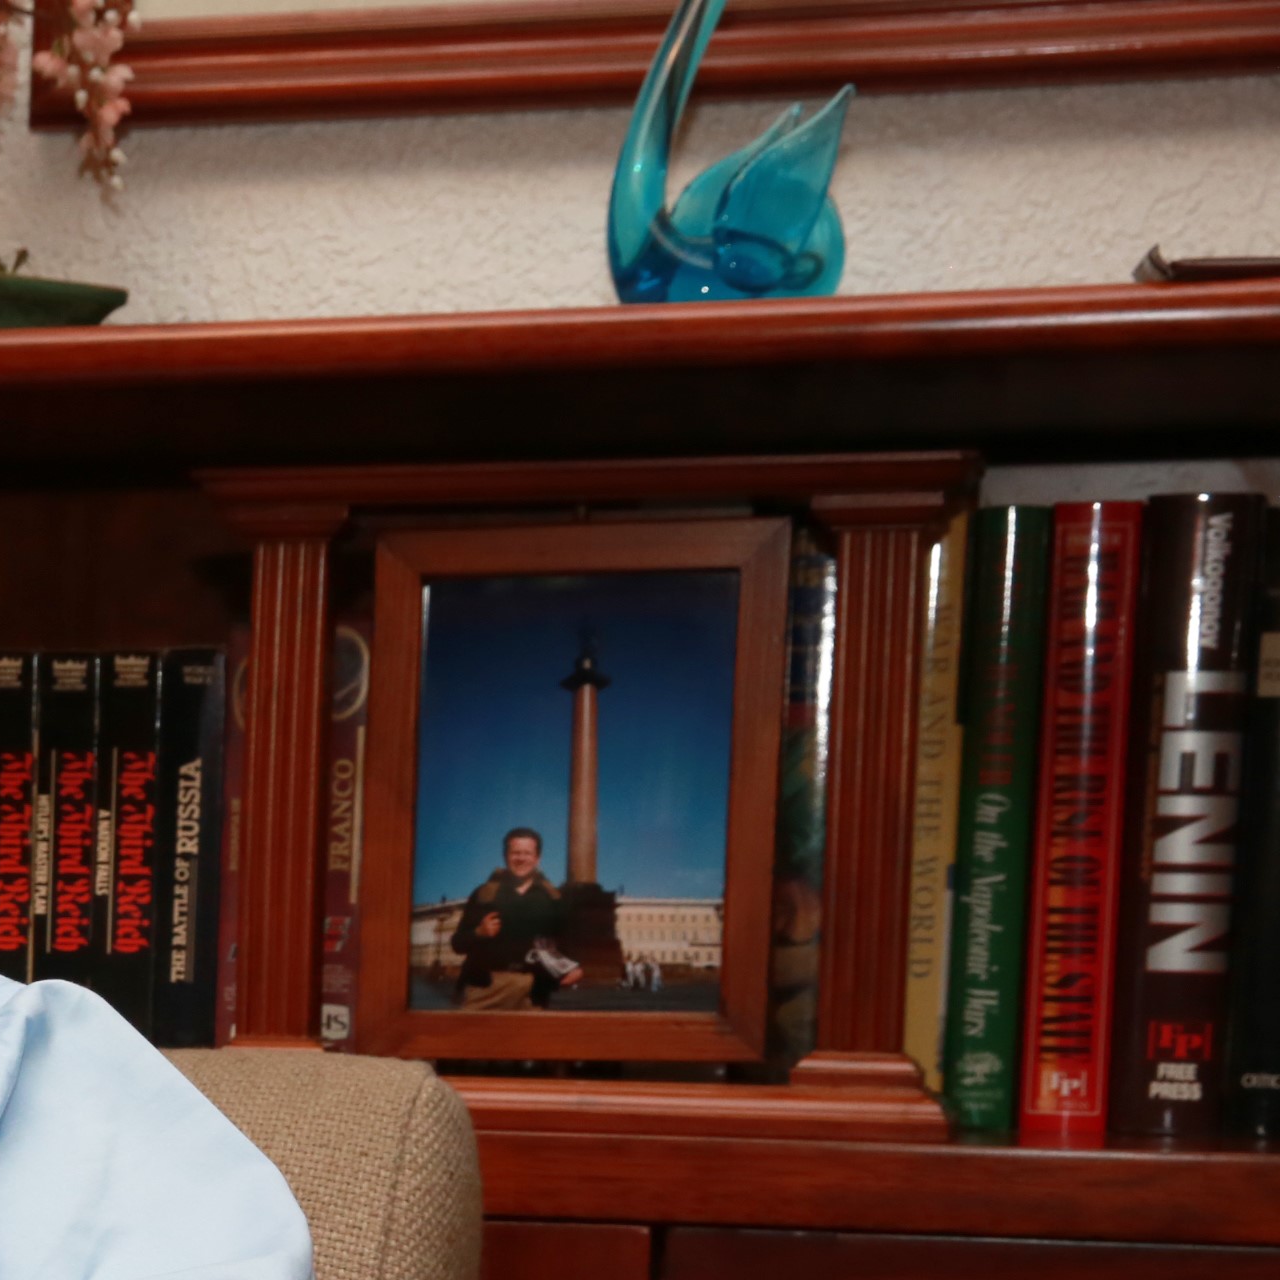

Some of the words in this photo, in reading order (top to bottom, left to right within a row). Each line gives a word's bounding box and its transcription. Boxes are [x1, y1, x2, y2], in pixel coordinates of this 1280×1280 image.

[1200, 510, 1235, 650] Volkogonov
[920, 689, 948, 763] AND
[58, 751, 97, 800] The
[119, 751, 157, 800] The
[175, 757, 202, 855] RUSSIA
[1050, 771, 1107, 843] RISE
[55, 802, 95, 877] Third
[96, 820, 111, 861] NATION
[117, 802, 156, 877] Third
[327, 758, 355, 872] FRANCO
[915, 777, 942, 850] THE
[973, 792, 1012, 826] On
[1146, 671, 1246, 973] LENIN
[173, 857, 191, 881] OF
[973, 828, 1007, 864] the
[1048, 853, 1104, 892] OF
[95, 864, 110, 896] FALLS
[52, 879, 93, 952] Reich
[113, 879, 154, 954] Reich
[171, 885, 190, 946] BATTLE
[909, 854, 937, 981] WORLD
[960, 869, 1006, 980] Napoleonic
[1046, 903, 1100, 961] THE
[170, 948, 188, 983] THE
[962, 984, 1002, 1039] Wars
[1040, 972, 1096, 1061] STATE
[1148, 1081, 1202, 1101] PRESS
[1156, 1061, 1199, 1080] FREE
